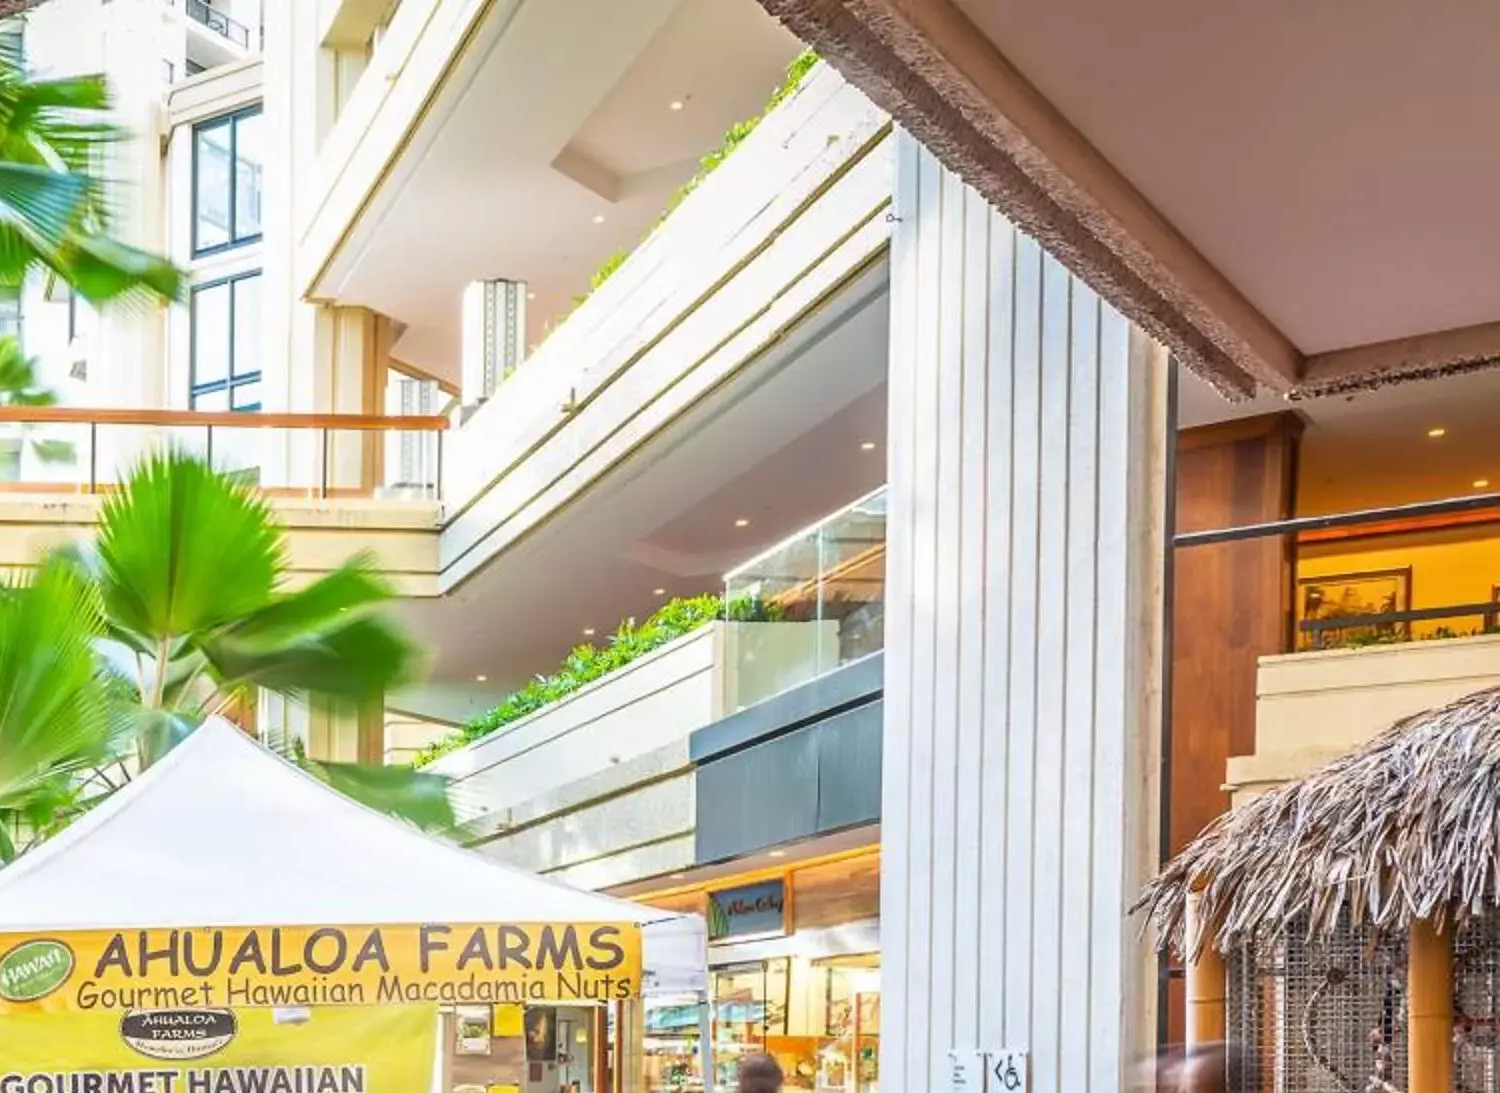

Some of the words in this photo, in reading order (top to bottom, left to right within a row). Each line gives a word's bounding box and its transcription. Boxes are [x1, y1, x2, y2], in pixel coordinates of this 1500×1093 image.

[95, 928, 390, 978] AHUALOA
[419, 924, 625, 974] FARMS
[77, 980, 215, 1010] Gourmet
[227, 976, 364, 1006] Hawaiian
[376, 973, 545, 1002] Macadamia
[557, 973, 631, 1000] Nuts
[141, 1013, 217, 1027] AHUALOA
[151, 1028, 208, 1040] FARMS
